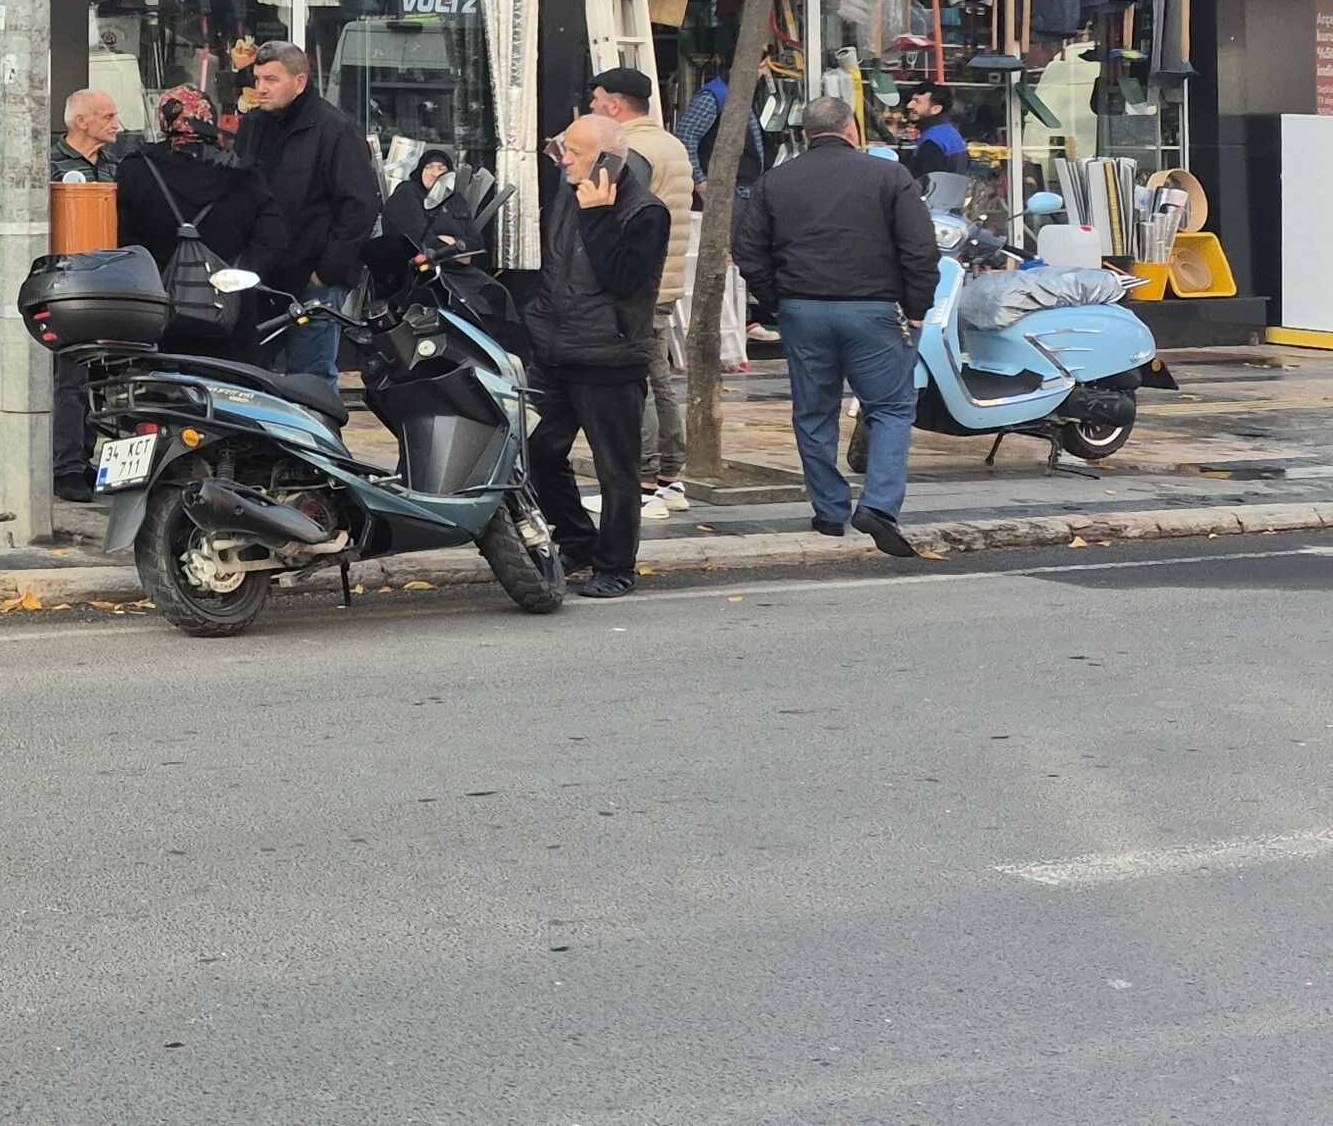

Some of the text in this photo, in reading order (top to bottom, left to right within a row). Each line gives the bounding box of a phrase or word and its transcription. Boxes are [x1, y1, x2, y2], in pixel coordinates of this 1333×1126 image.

[105, 439, 151, 462] 34 KCT
[118, 458, 141, 477] 711
